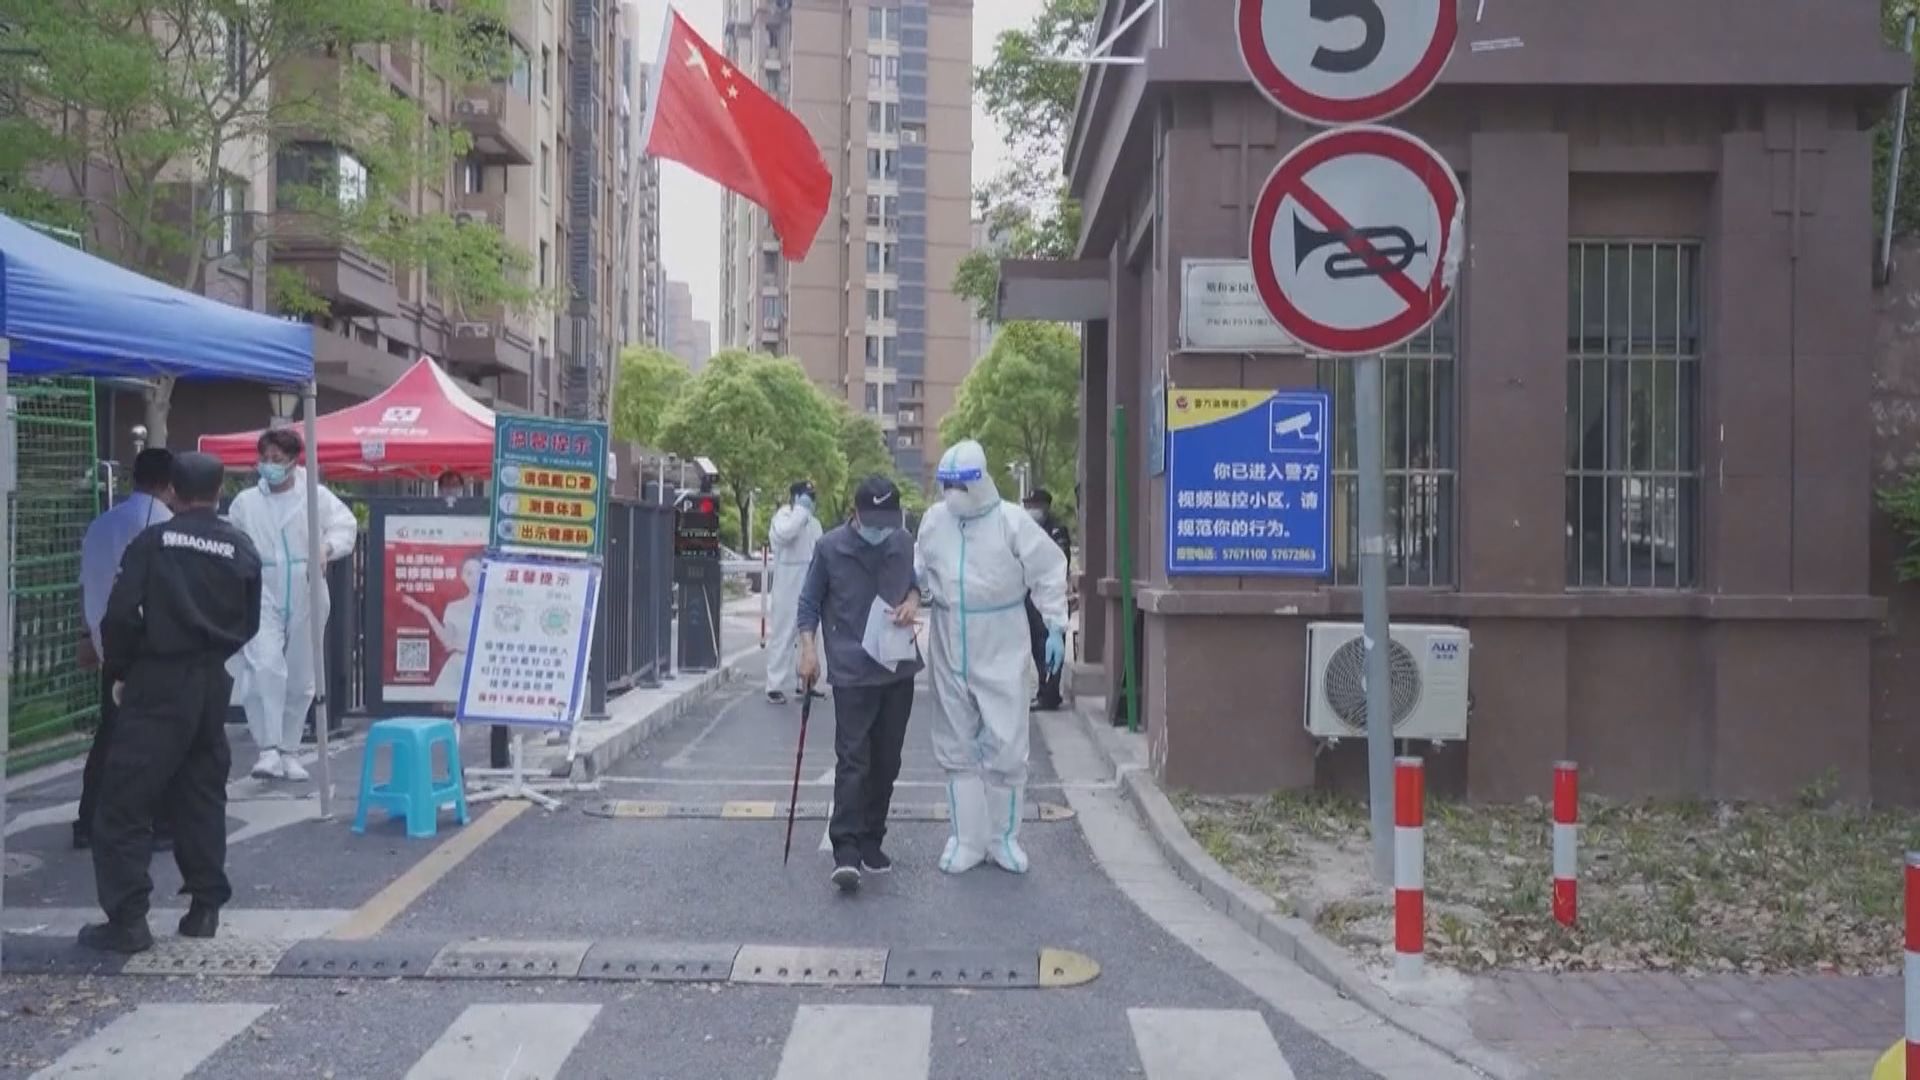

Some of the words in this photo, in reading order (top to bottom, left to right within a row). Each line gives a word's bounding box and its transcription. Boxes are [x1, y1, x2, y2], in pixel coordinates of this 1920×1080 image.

[1310, 0, 1385, 73] 5
[524, 471, 592, 490] 请佩戴口罩
[1213, 462, 1320, 481] 你已进入警方
[528, 498, 583, 517] 测量体温
[683, 500, 693, 513] P
[1177, 490, 1318, 509] 视频监控小区，请
[521, 523, 588, 544] 出示健康码
[1177, 518, 1291, 537] 规范你的行为。
[1222, 548, 1267, 561] 57671100
[506, 568, 570, 587] 温馨提示
[1432, 642, 1459, 652] AUX
